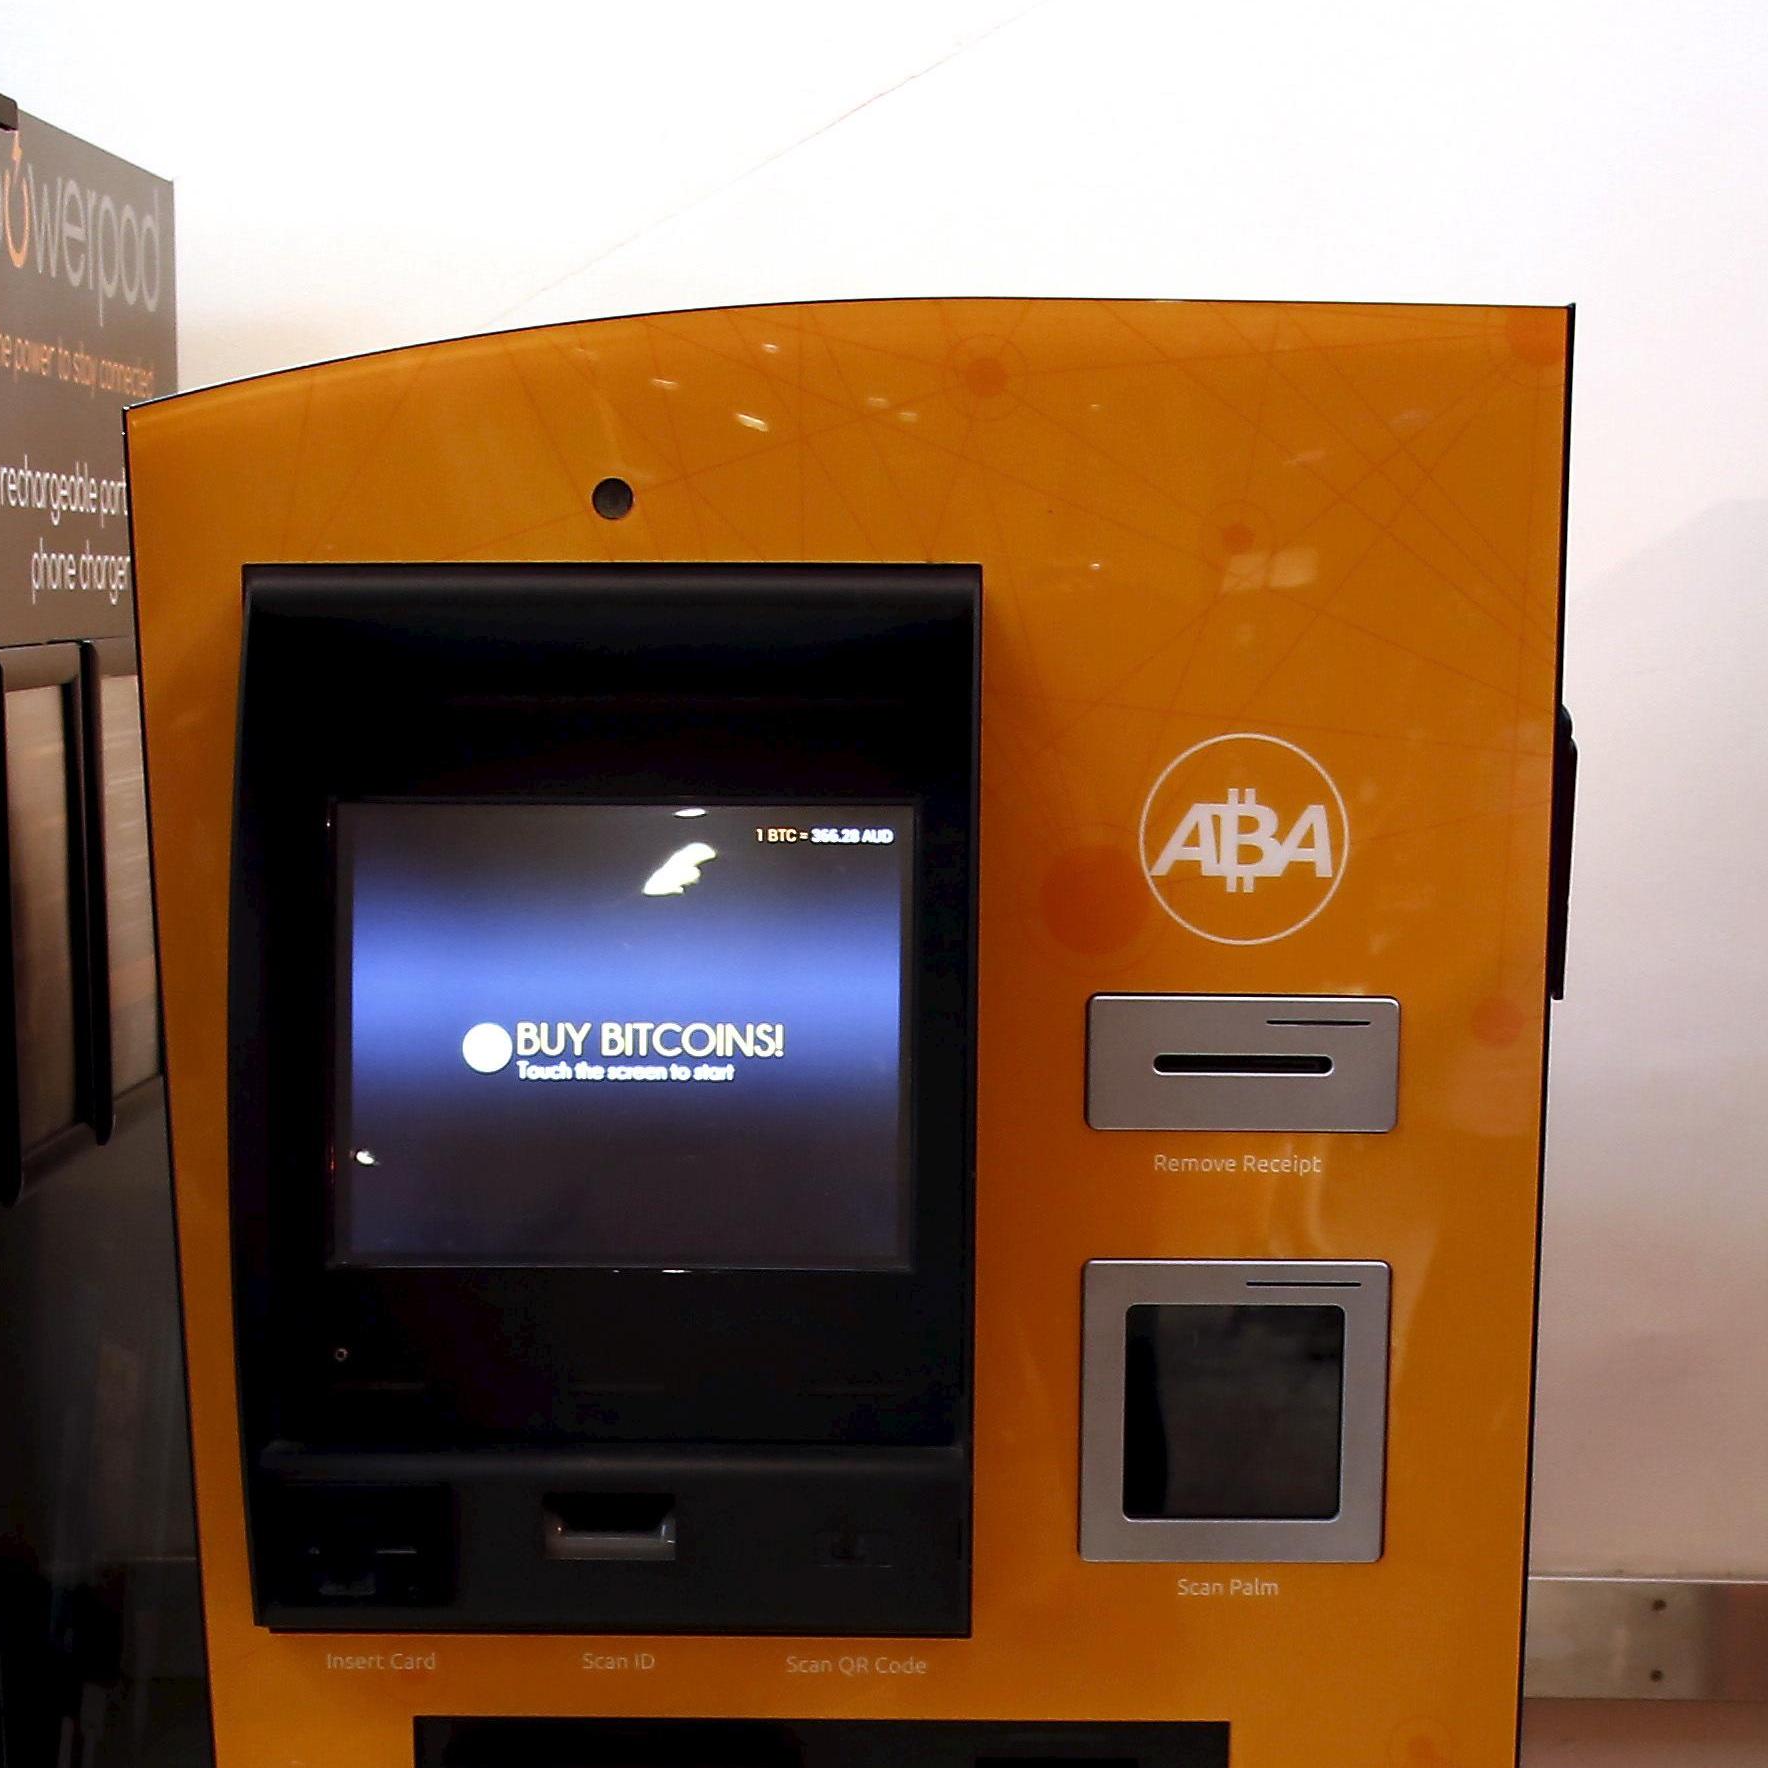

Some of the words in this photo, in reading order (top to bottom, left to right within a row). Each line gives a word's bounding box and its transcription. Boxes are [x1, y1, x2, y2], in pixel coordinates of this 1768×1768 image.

[0, 454, 97, 525] rechargeable
[100, 467, 128, 528] port
[32, 537, 76, 605] phone
[79, 539, 131, 605] charger
[756, 828, 763, 842] 1
[767, 828, 797, 843] BTC
[861, 828, 894, 844] AUD
[517, 1022, 592, 1057] BUY
[600, 1022, 784, 1057] BITCOINS!
[517, 1061, 572, 1080] Touch
[575, 1061, 605, 1080] the
[607, 1063, 668, 1081] screen
[669, 1063, 691, 1081] to
[693, 1063, 735, 1082] start
[1153, 1154, 1236, 1174] Remove
[1243, 1154, 1322, 1178] Receipt
[1177, 1579, 1224, 1596] Scan
[1230, 1579, 1279, 1596] Palm
[326, 1653, 387, 1672] Insert
[391, 1652, 436, 1672] Card
[581, 1652, 628, 1671] Scan
[634, 1653, 655, 1671] ID
[786, 1655, 832, 1674] Scan
[837, 1655, 871, 1677] QR
[875, 1655, 928, 1675] Code
